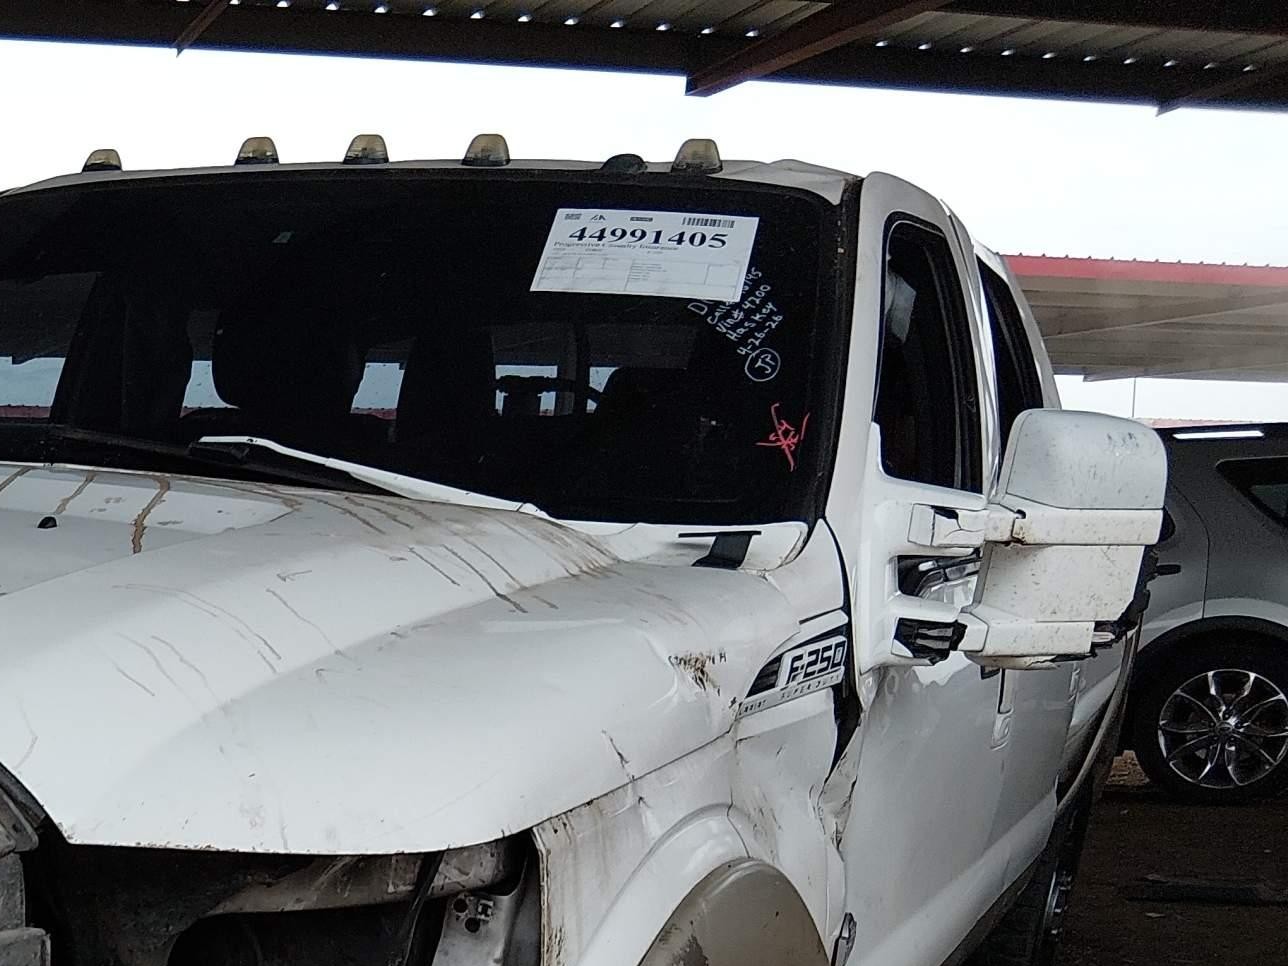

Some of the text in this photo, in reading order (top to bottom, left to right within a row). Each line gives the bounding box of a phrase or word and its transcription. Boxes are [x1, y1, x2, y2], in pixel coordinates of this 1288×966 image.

[568, 226, 729, 249] 44991405
[742, 284, 772, 309] 4200
[785, 640, 847, 685] F-250
